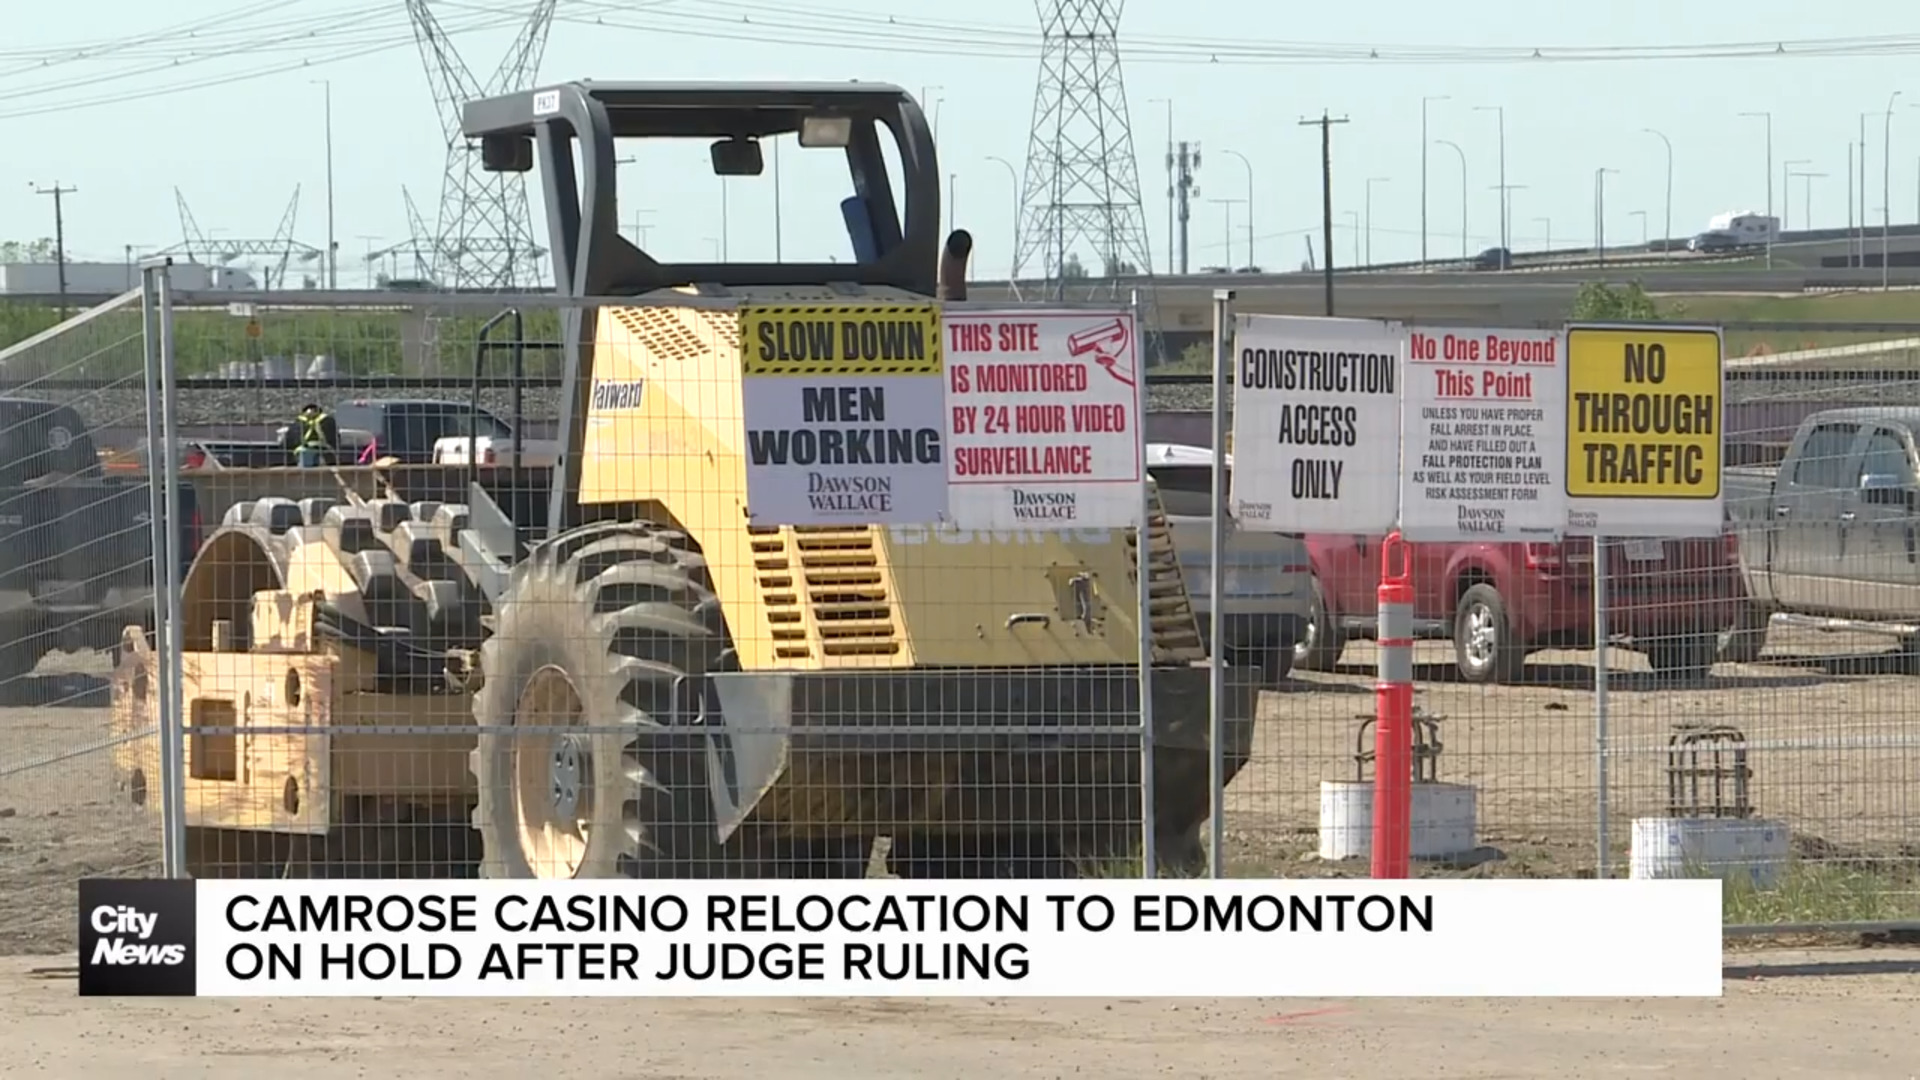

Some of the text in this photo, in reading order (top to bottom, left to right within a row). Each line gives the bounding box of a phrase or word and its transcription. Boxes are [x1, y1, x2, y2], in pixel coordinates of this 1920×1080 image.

[758, 321, 925, 361] SLOW DOWN
[949, 323, 1039, 352] THIS SITE
[1411, 333, 1556, 365] No One Beyond
[1242, 348, 1395, 394] CONSTRUCTION
[1624, 343, 1666, 384] NO
[950, 364, 1087, 393] IS MONITORED
[1435, 369, 1532, 397] This Point
[802, 386, 885, 422] MEN
[1422, 407, 1543, 421] UNLESS YOU HAVE PROPER
[1574, 392, 1713, 434] THROUGH
[952, 404, 1126, 434] BY 24 HOUR VIDEO
[1278, 404, 1357, 447] ACCESS
[1430, 423, 1451, 435] FALL
[1454, 424, 1489, 435] ARREST
[1491, 424, 1501, 435] IN
[748, 428, 941, 465] WORKING
[955, 446, 1092, 475] SURVEILLANCE
[1428, 440, 1536, 453] AND HAVE FILLED OUT A
[1422, 455, 1542, 469] FALL PROTECTION PLAN
[1583, 443, 1703, 484] TRAFFIC
[808, 472, 891, 493] DAWSON
[1292, 458, 1343, 500] ONLY
[1413, 471, 1551, 484] AS WELL AS YOUR FIELD LEVEL
[808, 495, 892, 512] WALLACE
[1013, 489, 1076, 506] DAWSON
[1426, 487, 1537, 500] RISK ASSESSMENT FORM
[1013, 506, 1076, 519] WALLACE
[1457, 505, 1505, 519] DAWSON
[1457, 521, 1505, 533] WALLACE
